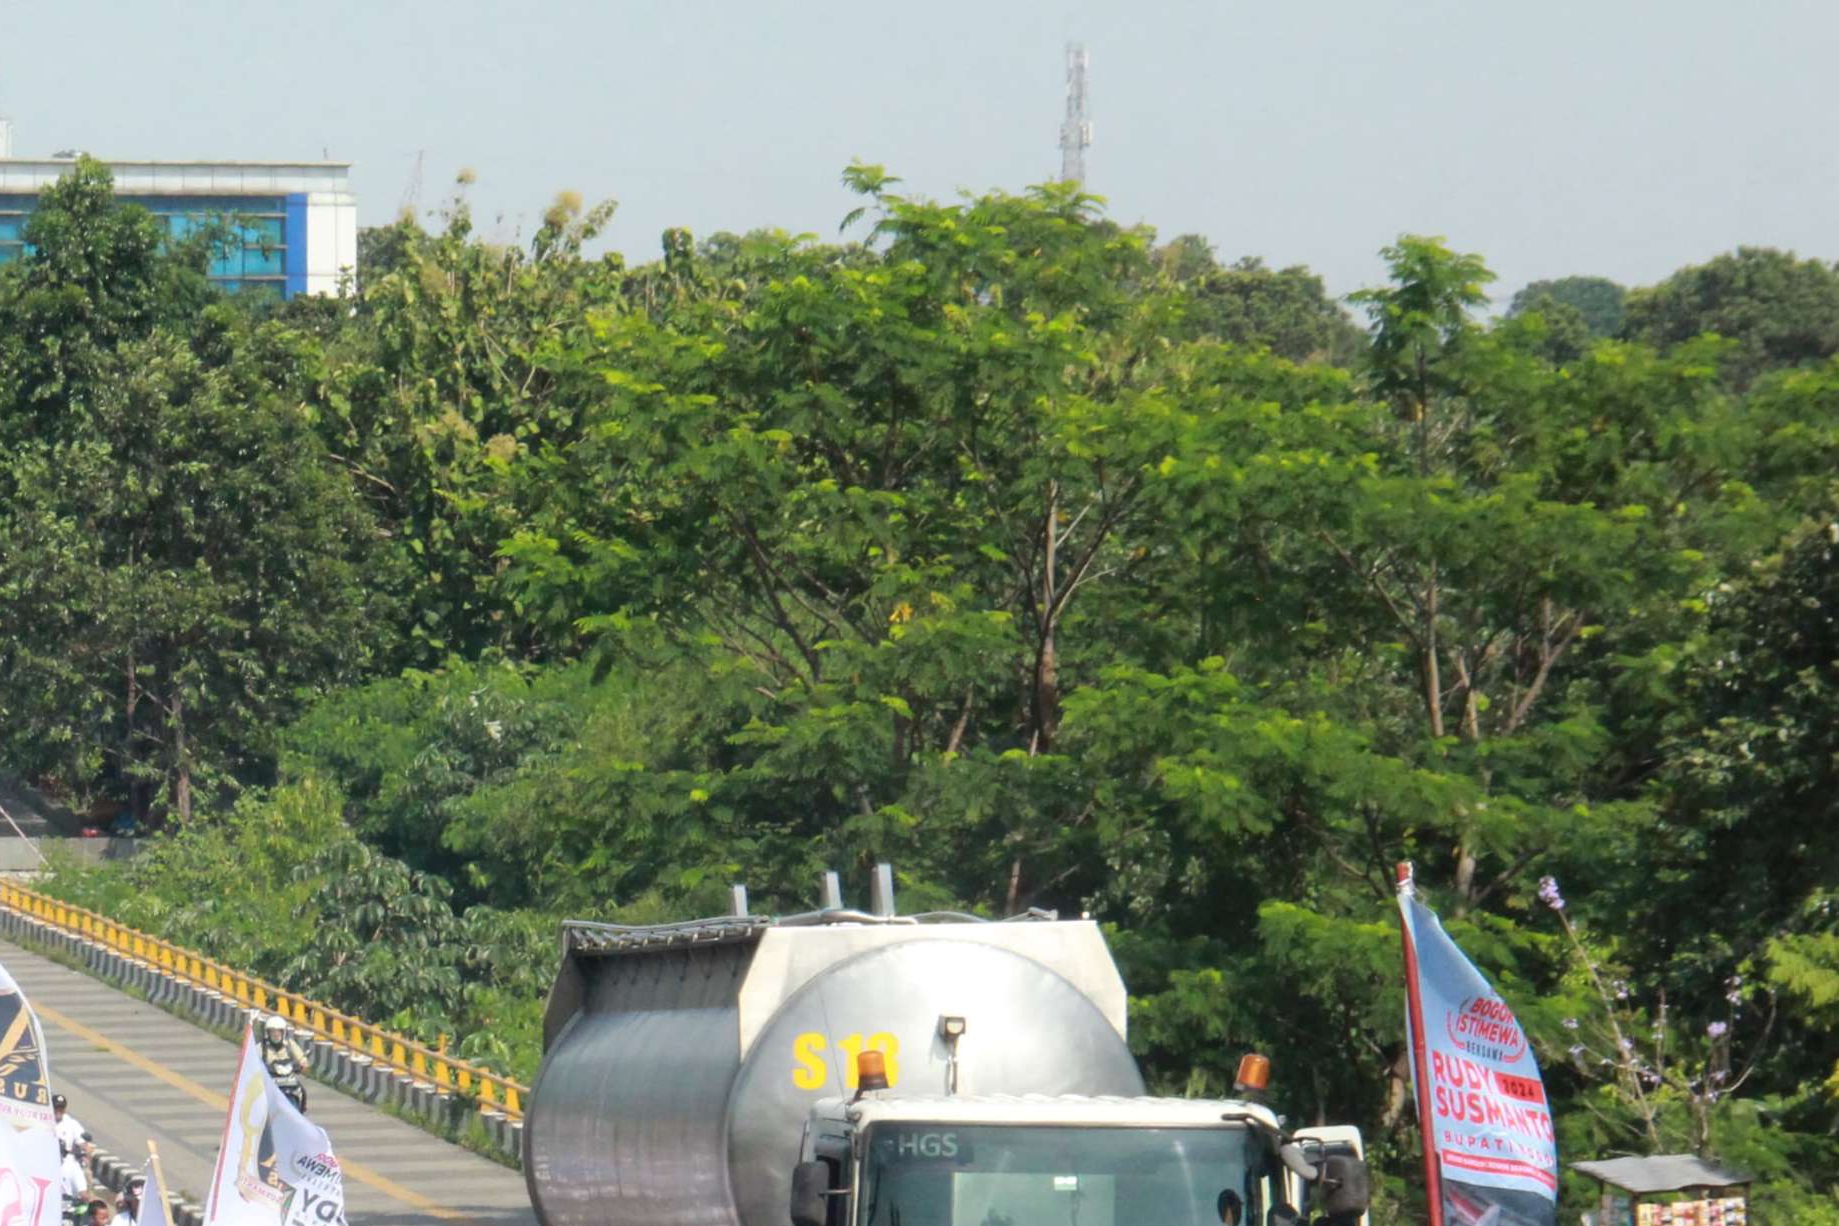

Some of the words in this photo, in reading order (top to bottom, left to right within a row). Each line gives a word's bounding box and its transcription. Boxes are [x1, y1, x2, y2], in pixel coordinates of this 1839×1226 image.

[1456, 1013, 1519, 1047] ISTIMEWA
[793, 1033, 827, 1089] S
[1432, 1050, 1492, 1095] RUDY
[1435, 1085, 1555, 1143] SUSMANTO
[898, 1132, 958, 1157] HGS
[1444, 1130, 1514, 1153] BUPATI
